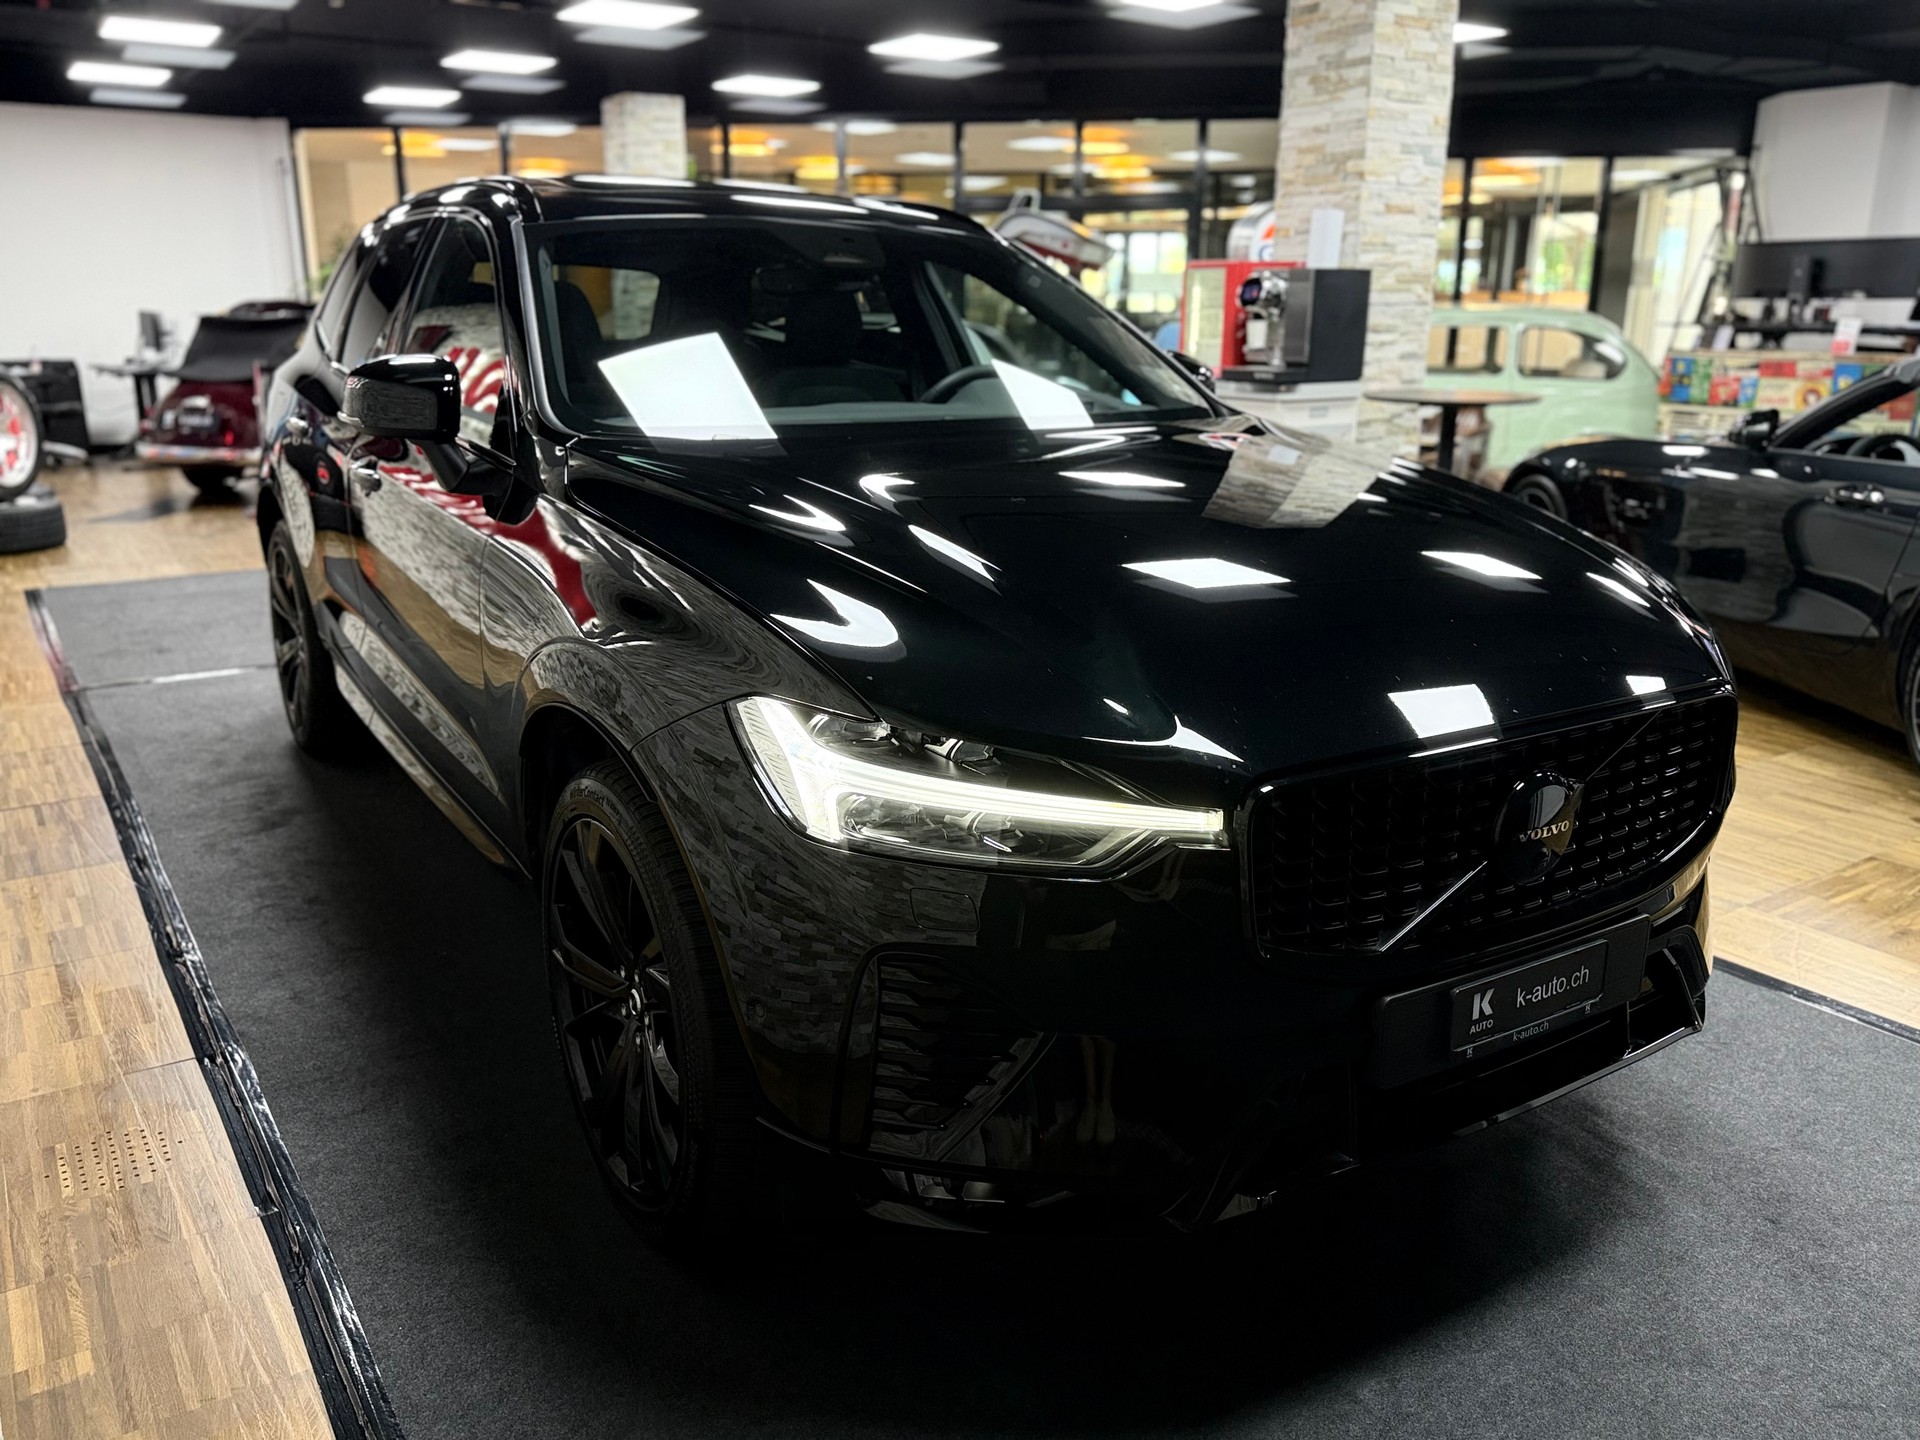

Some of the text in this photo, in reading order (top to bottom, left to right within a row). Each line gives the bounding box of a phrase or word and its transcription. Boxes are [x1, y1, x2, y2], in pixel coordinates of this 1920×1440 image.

[1519, 820, 1569, 842] VOLVO
[1516, 965, 1590, 1008] k-auto.ch
[1472, 988, 1495, 1020] K
[1469, 1019, 1494, 1034] AUTO
[1513, 1021, 1549, 1042] k-auto.ch
